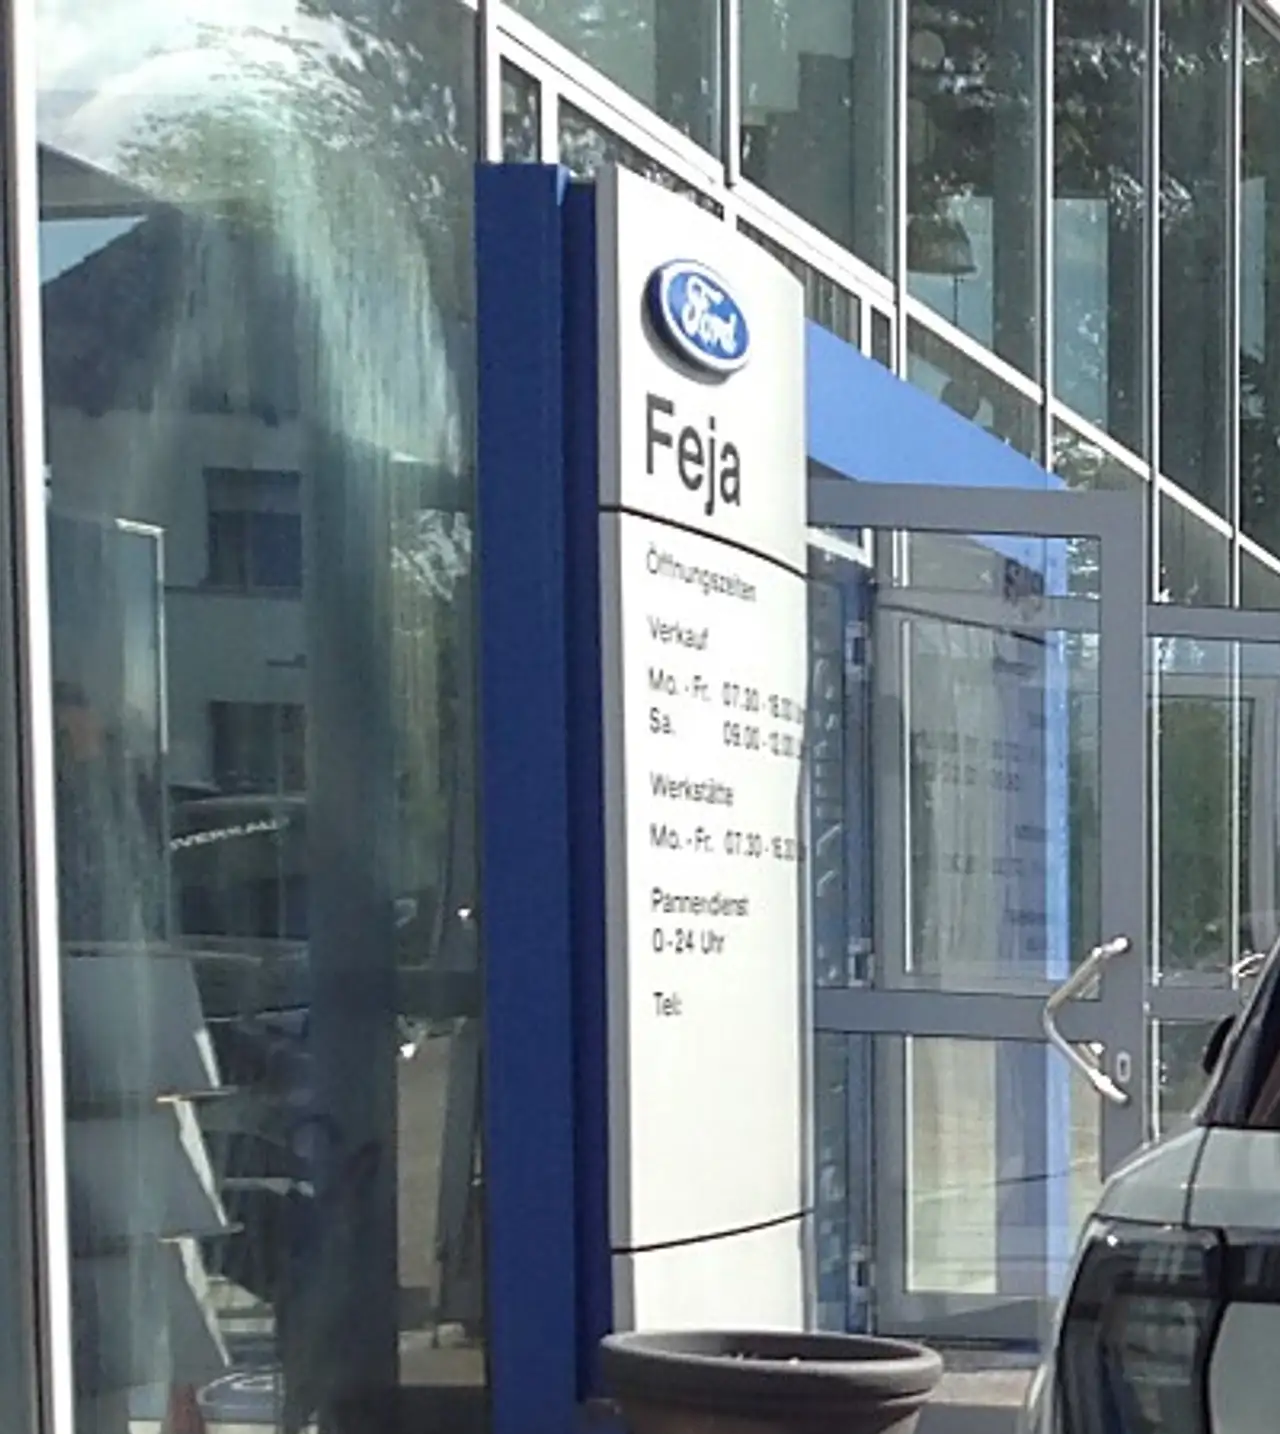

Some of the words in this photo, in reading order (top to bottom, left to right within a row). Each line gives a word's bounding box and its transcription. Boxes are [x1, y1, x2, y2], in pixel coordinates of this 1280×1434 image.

[681, 273, 738, 356] Ford
[645, 391, 741, 516] Feja
[647, 613, 709, 651] Verkauf
[649, 706, 677, 736] Sa.
[700, 928, 725, 955] Uhr
